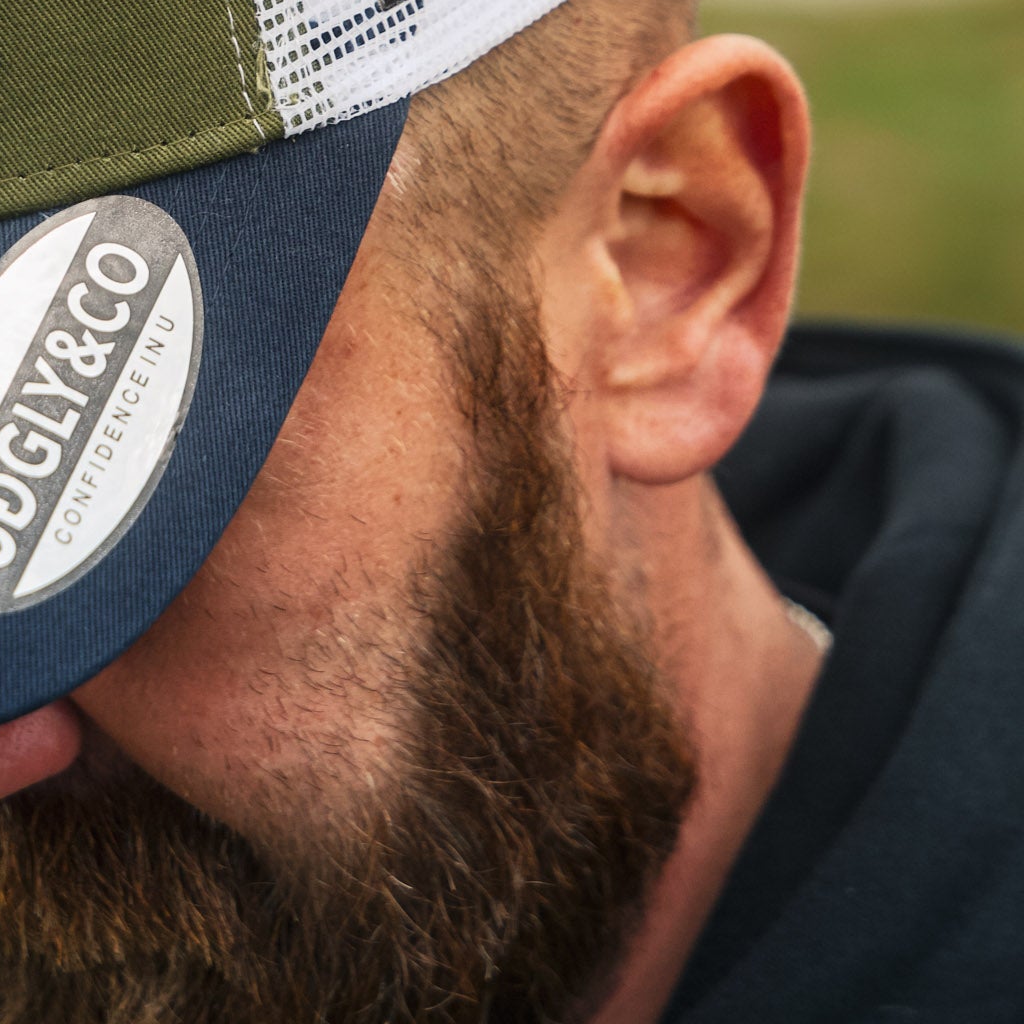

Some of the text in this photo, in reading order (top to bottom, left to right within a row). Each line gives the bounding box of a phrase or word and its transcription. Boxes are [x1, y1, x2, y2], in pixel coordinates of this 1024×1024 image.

[54, 314, 176, 546] CONFIDENCE IN U
